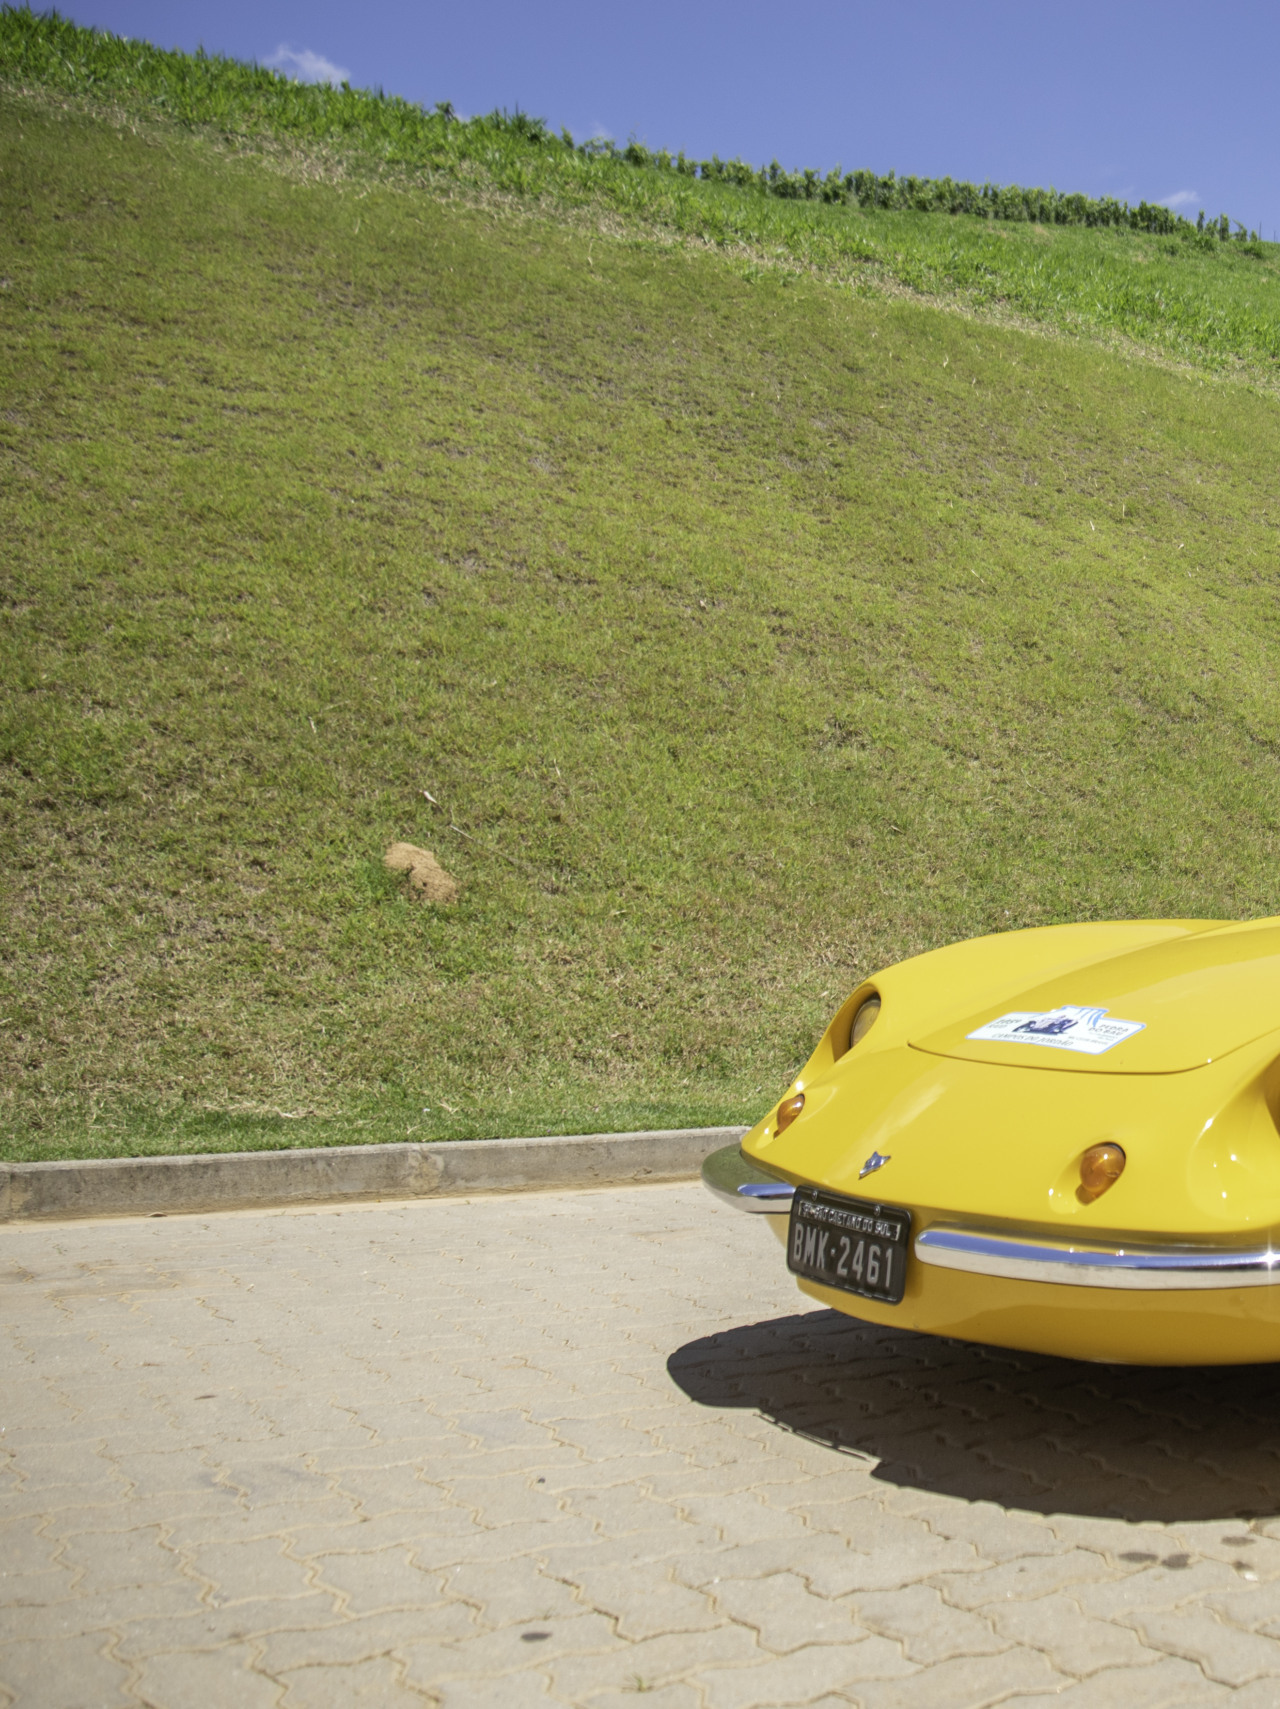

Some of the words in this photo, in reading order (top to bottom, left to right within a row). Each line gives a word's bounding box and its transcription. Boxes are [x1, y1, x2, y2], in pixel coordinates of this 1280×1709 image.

[829, 1209, 863, 1230] CAETANO
[874, 1222, 891, 1237] SUL
[793, 1222, 829, 1270] BMK
[837, 1235, 894, 1288] 2461
